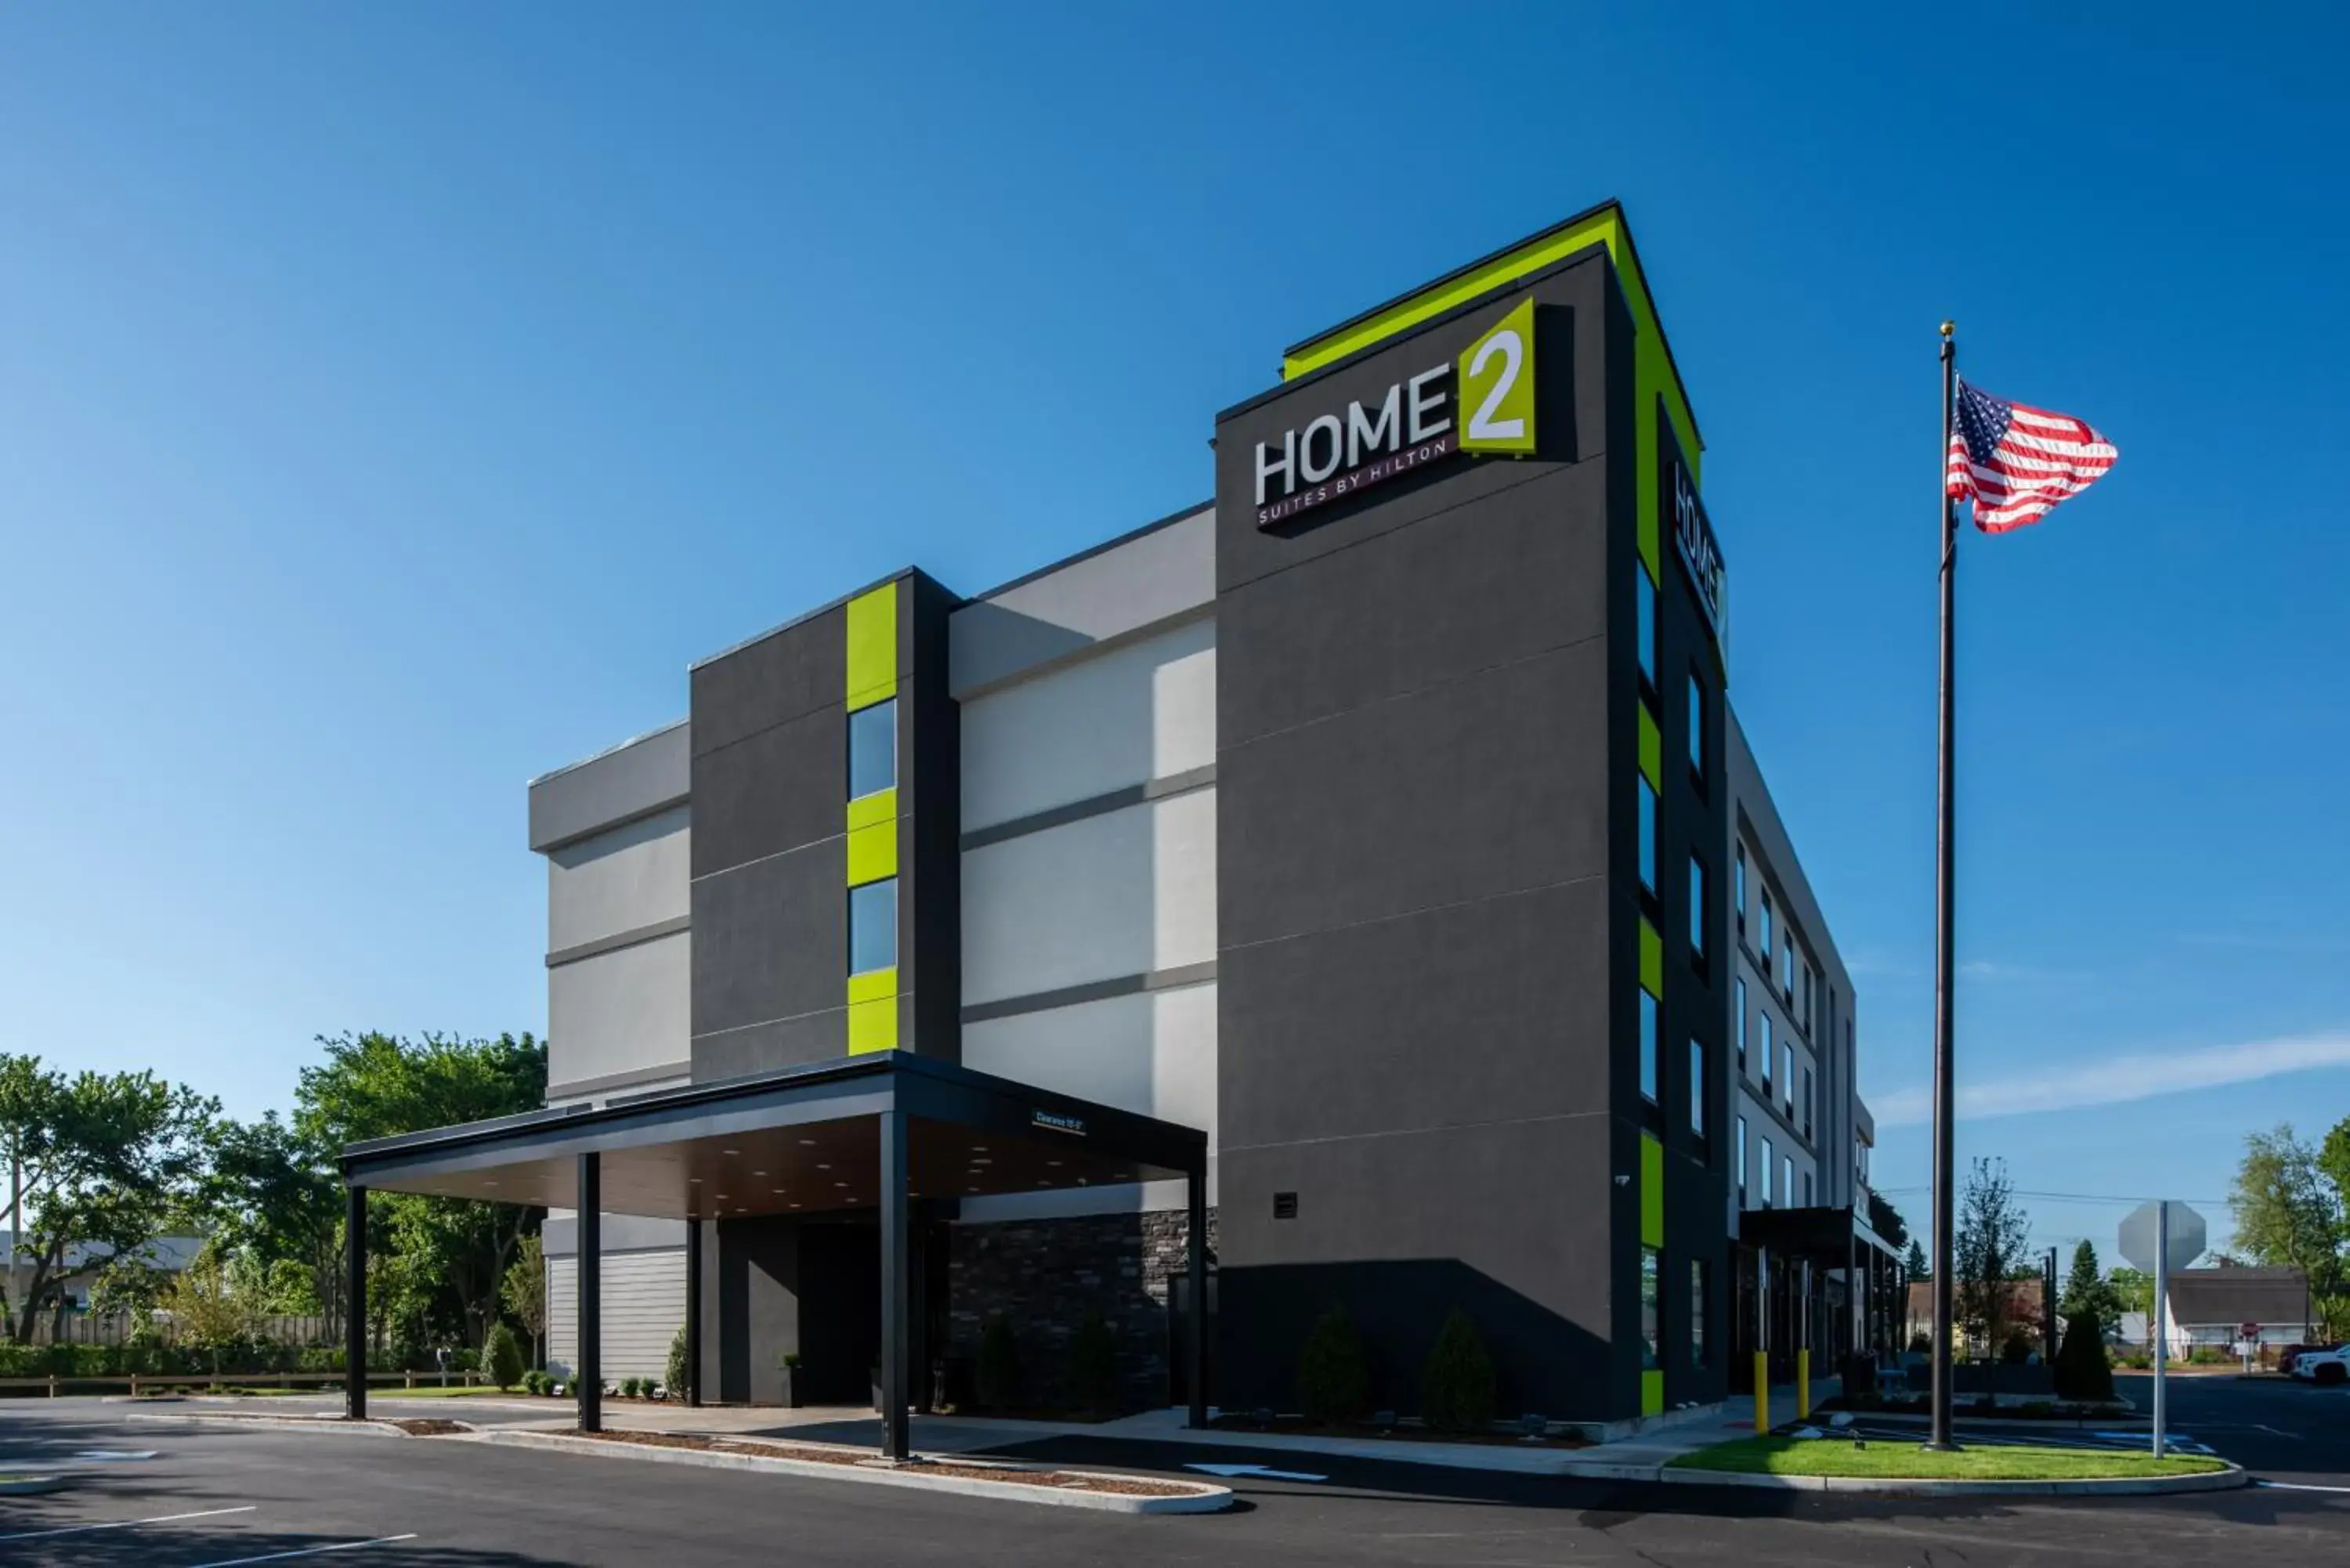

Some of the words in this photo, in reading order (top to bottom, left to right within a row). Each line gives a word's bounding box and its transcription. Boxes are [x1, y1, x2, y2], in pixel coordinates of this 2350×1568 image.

[1255, 363, 1451, 505] HOME
[1468, 329, 1524, 440] 2
[1259, 487, 1327, 525] SUITES
[1336, 472, 1360, 493] BY
[1370, 439, 1446, 480] HILTON
[1675, 461, 1716, 612] HOME
